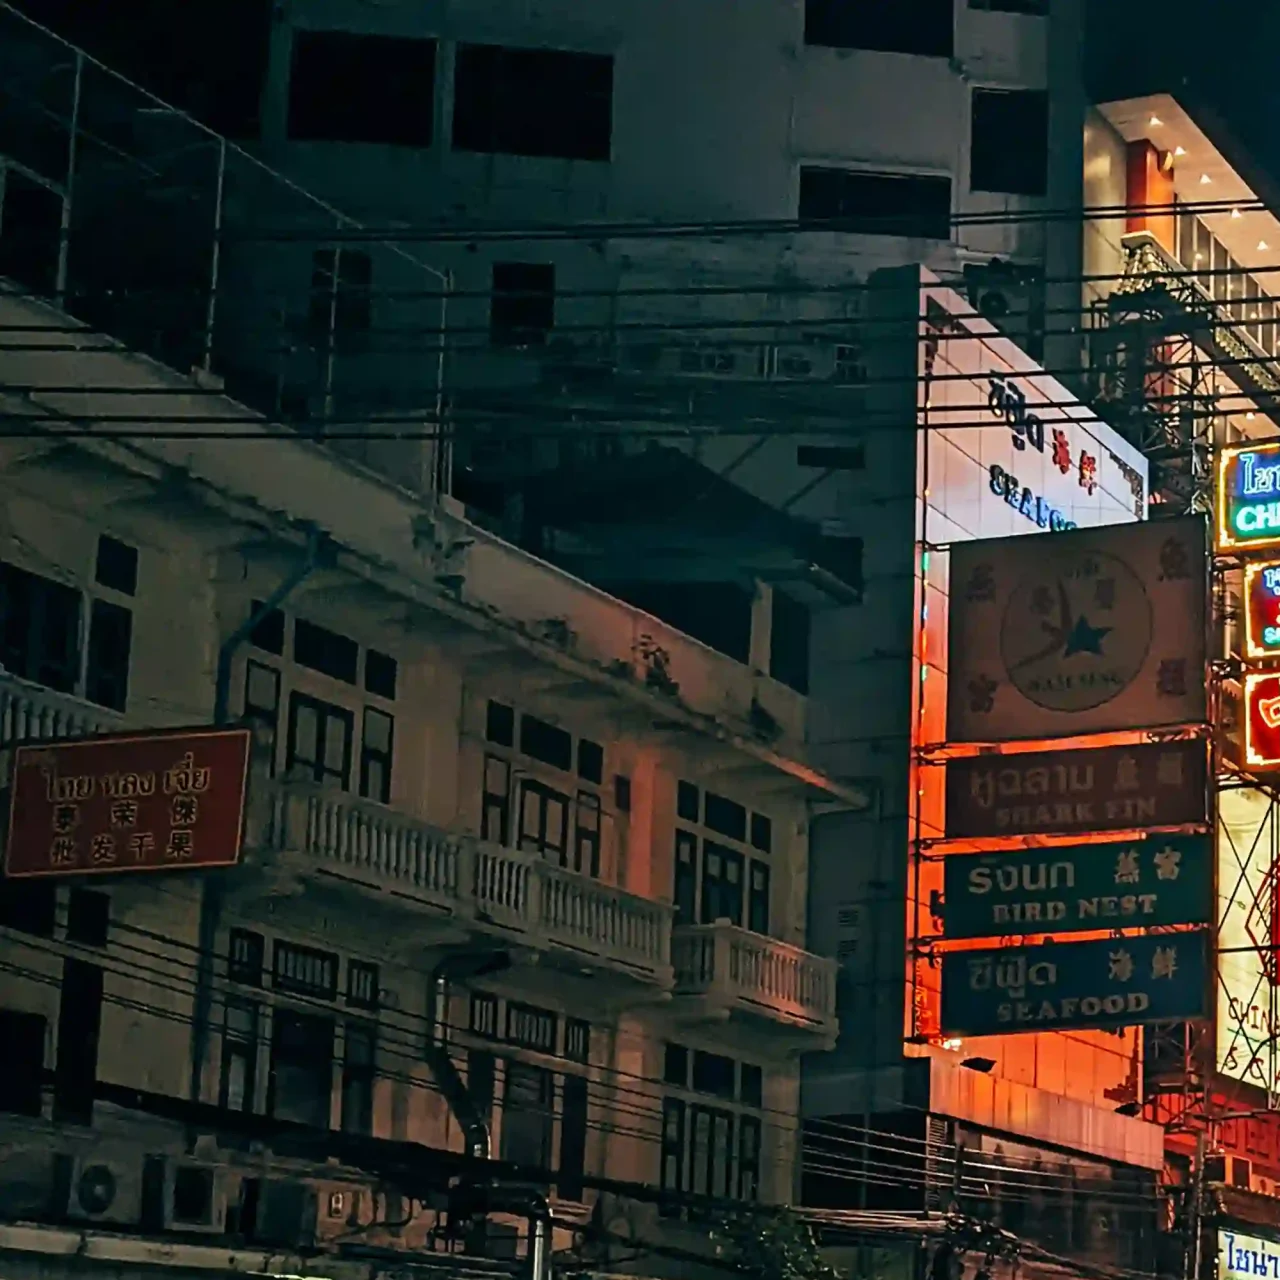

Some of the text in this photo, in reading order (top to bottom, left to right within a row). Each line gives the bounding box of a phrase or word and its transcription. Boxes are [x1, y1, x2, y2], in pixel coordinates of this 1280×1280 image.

[996, 797, 1156, 828] SHARK FIN
[968, 857, 1075, 894] รังนก
[993, 894, 1157, 924] BIRD NEST
[997, 993, 1149, 1022] SEAFOOD
